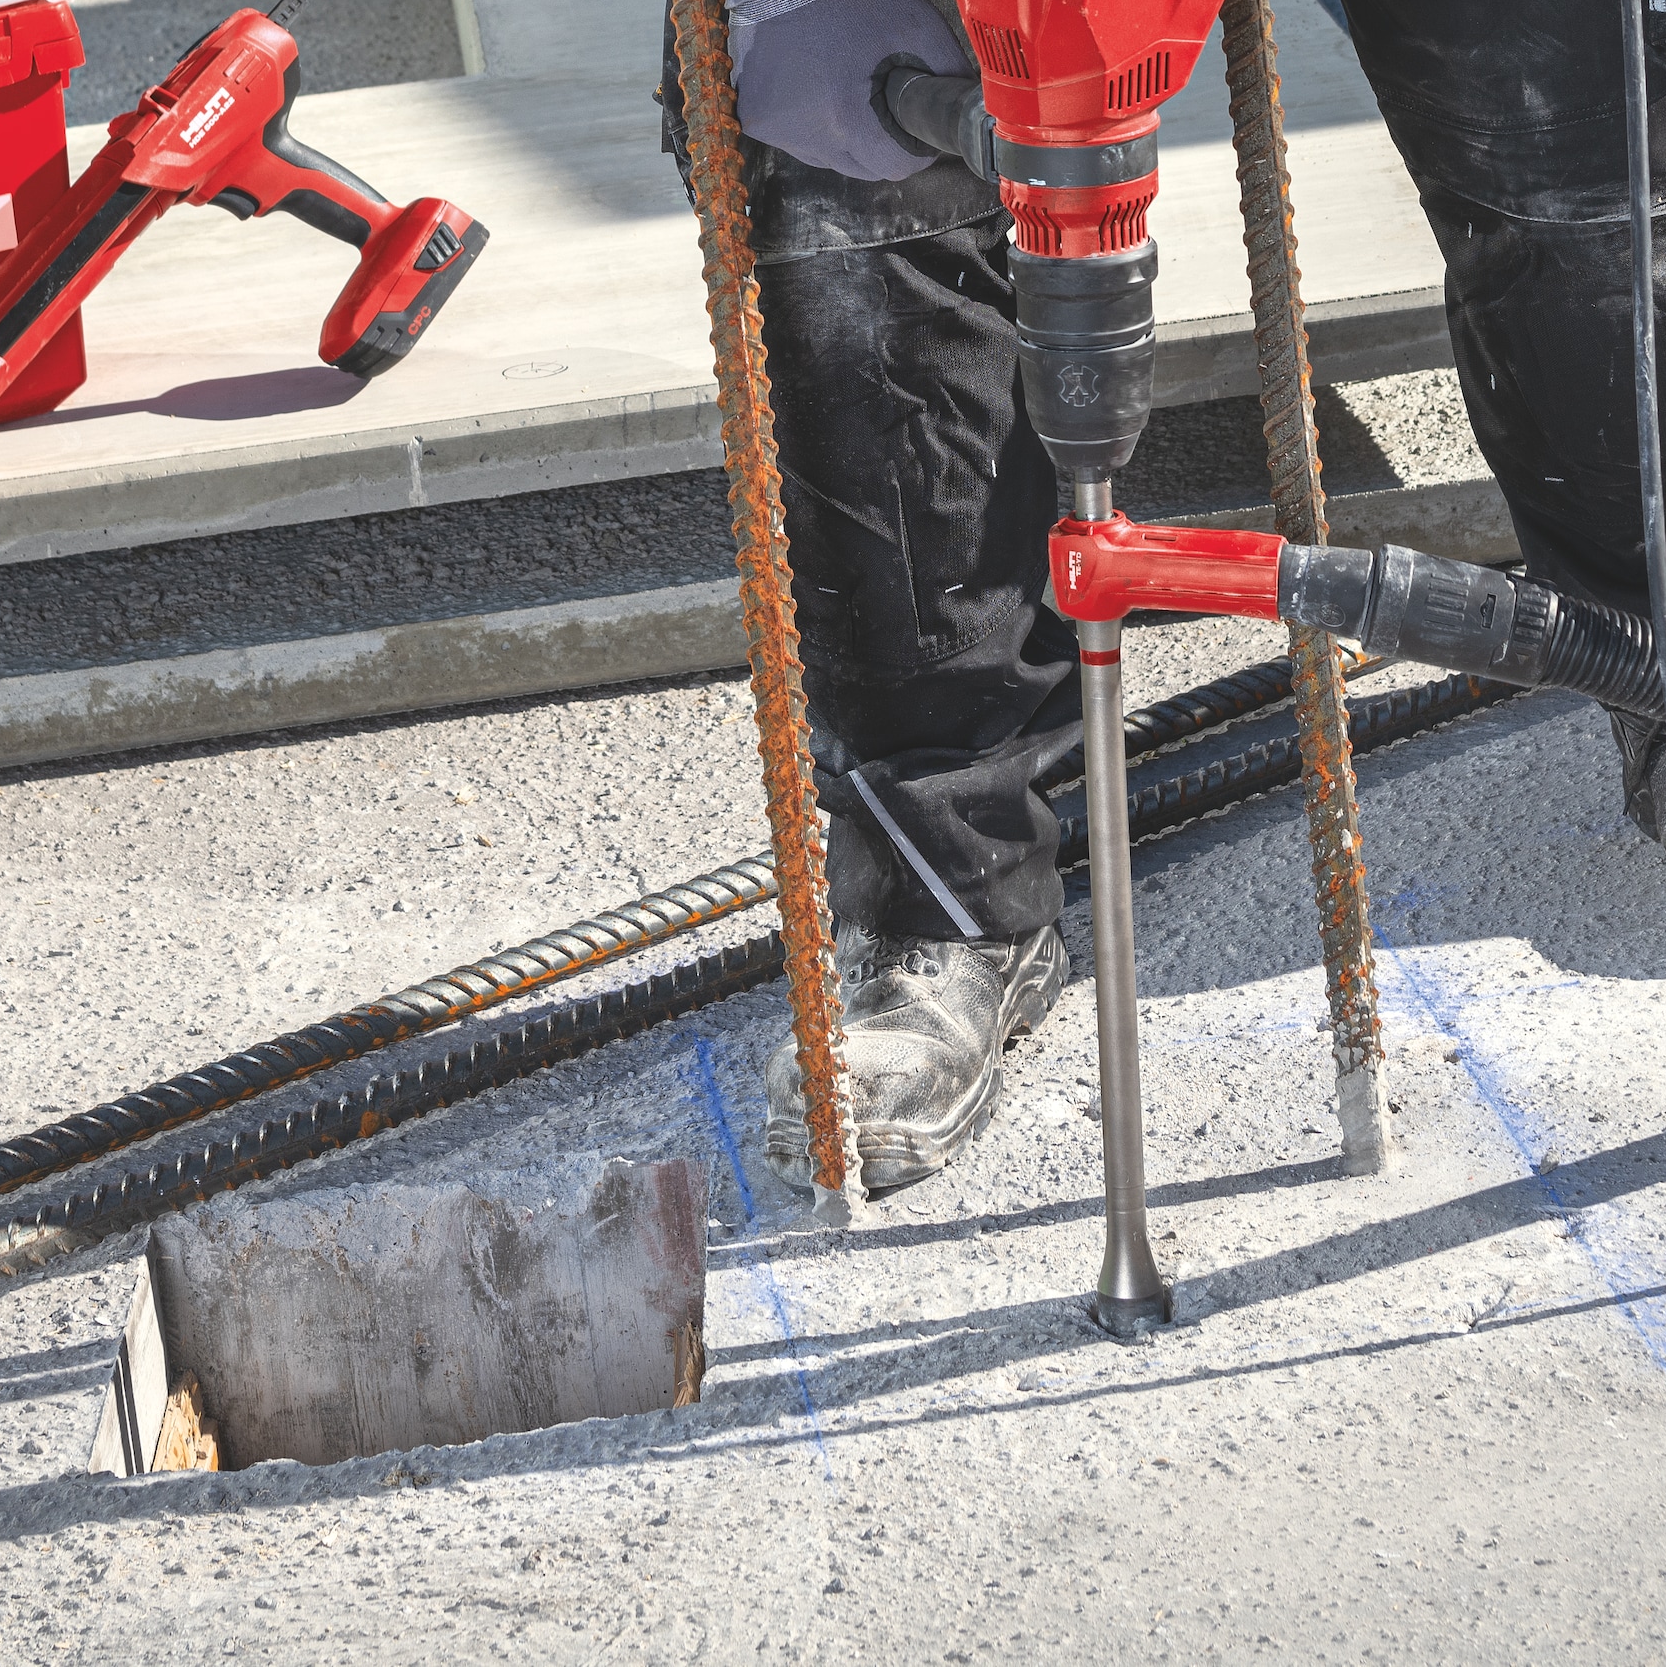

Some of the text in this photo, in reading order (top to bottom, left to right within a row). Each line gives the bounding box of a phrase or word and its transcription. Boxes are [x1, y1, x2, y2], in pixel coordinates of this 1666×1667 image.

[180, 87, 230, 143] HILTI
[188, 128, 206, 149] HDE
[408, 305, 432, 335] CPC
[1068, 550, 1077, 590] HILTI
